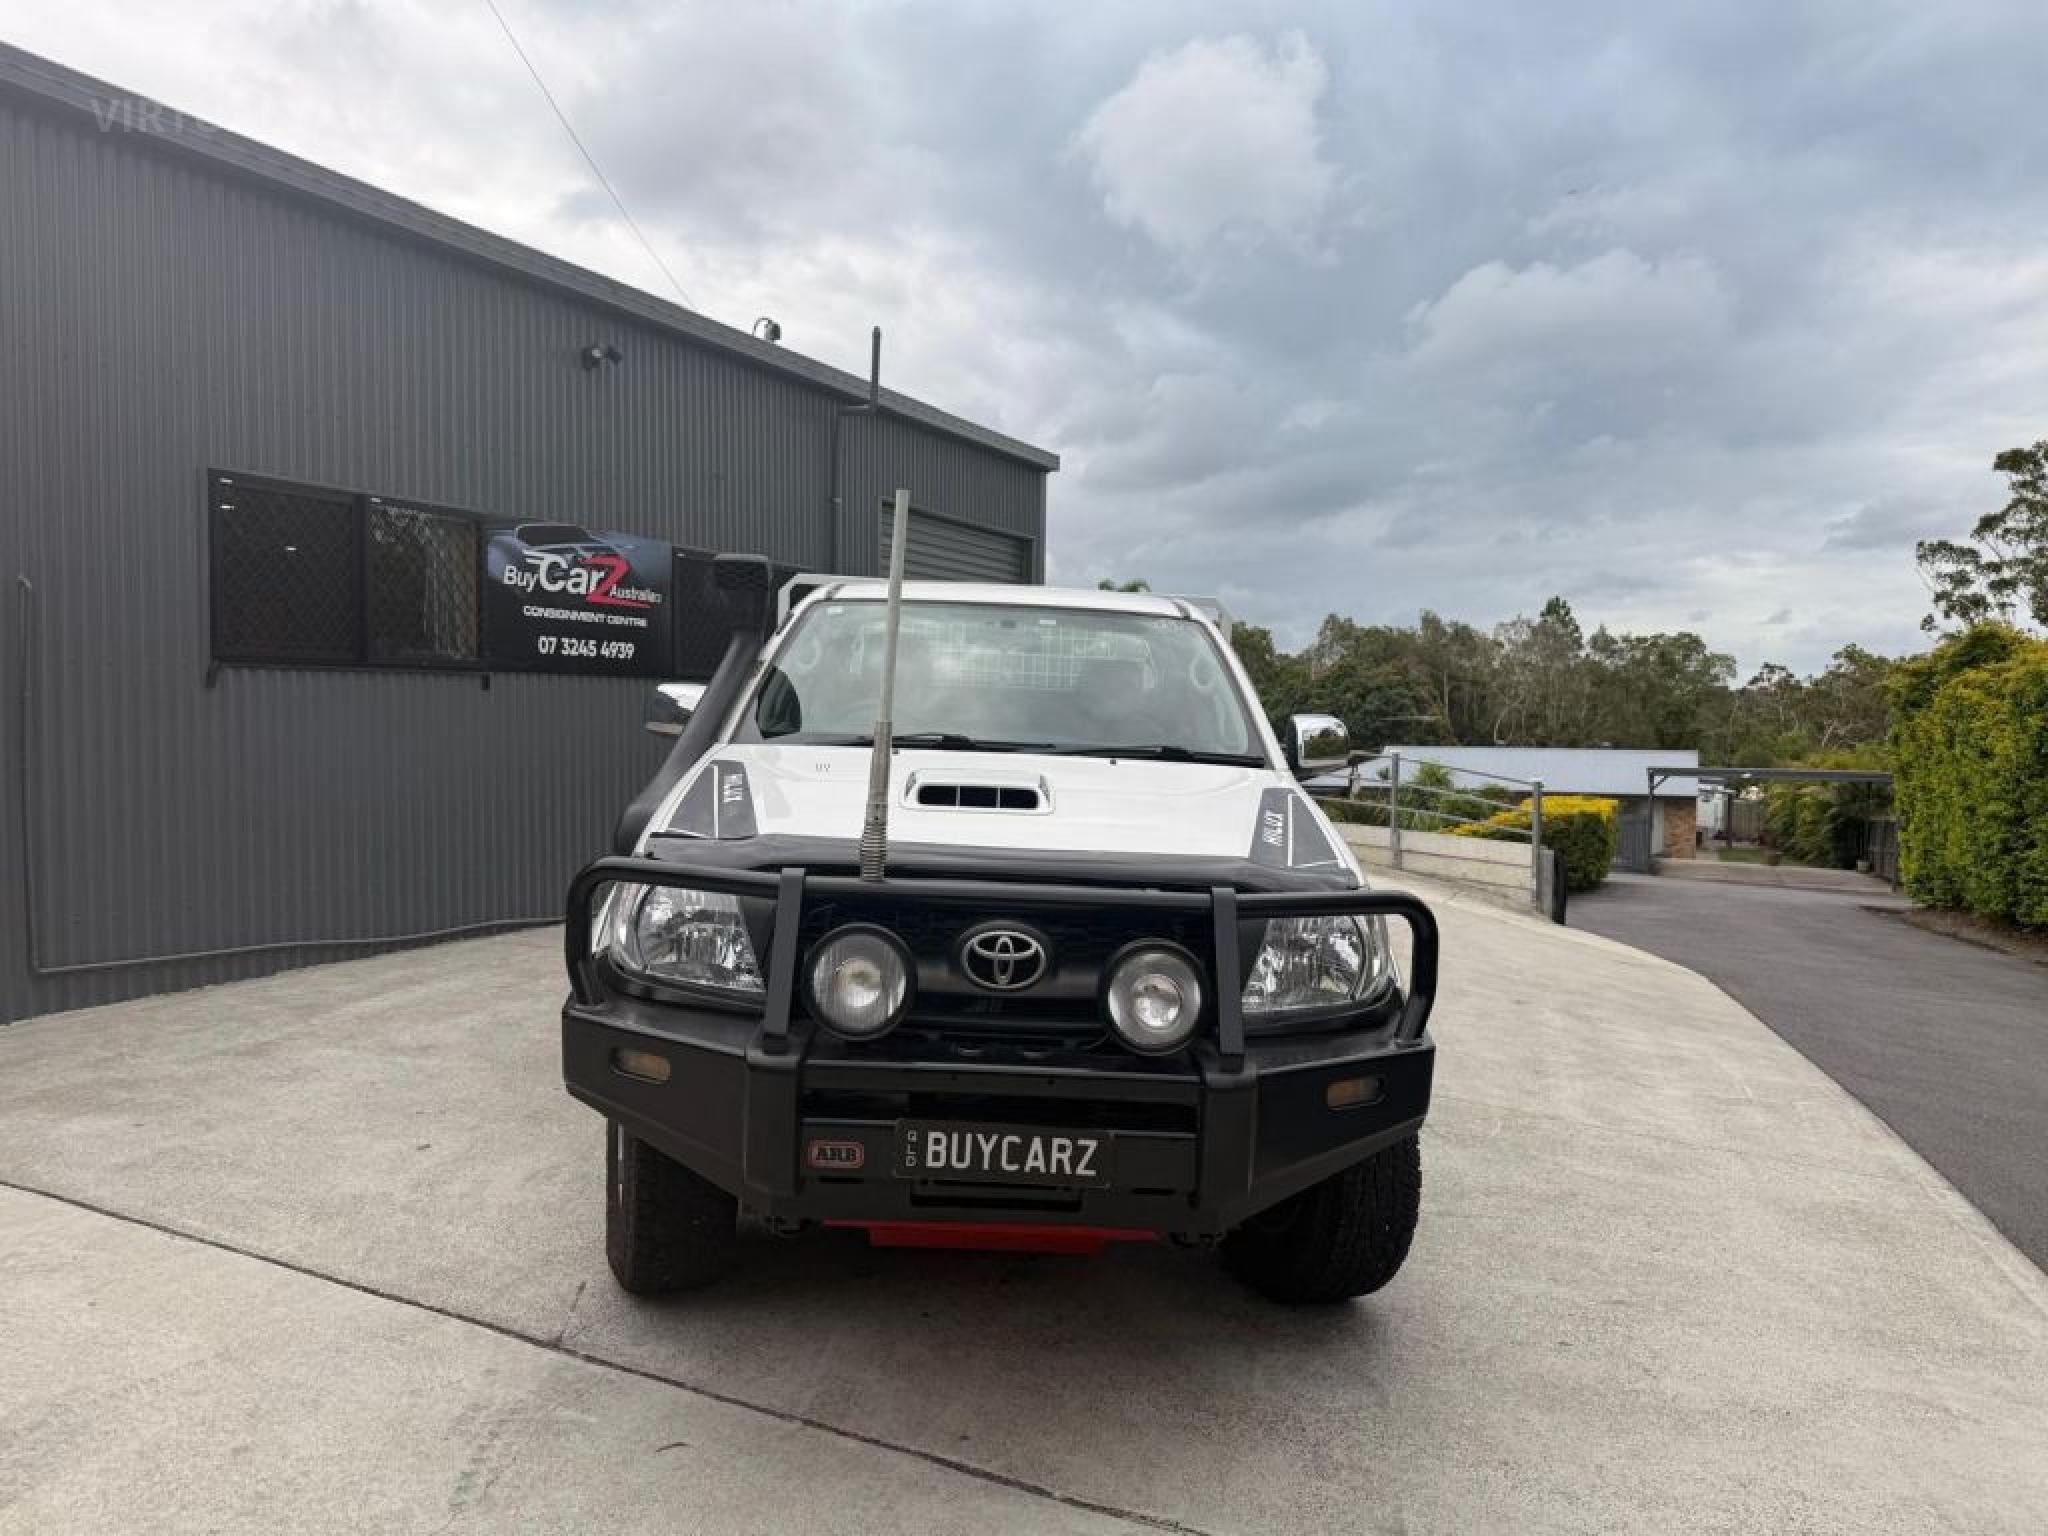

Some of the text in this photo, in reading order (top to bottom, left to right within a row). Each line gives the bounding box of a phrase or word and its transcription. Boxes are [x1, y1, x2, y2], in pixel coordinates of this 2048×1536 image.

[523, 606, 648, 627] CONSIGNMENT CENTRE
[538, 636, 635, 659] 07 3245 4939
[925, 1131, 1099, 1177] BUYCARZ
